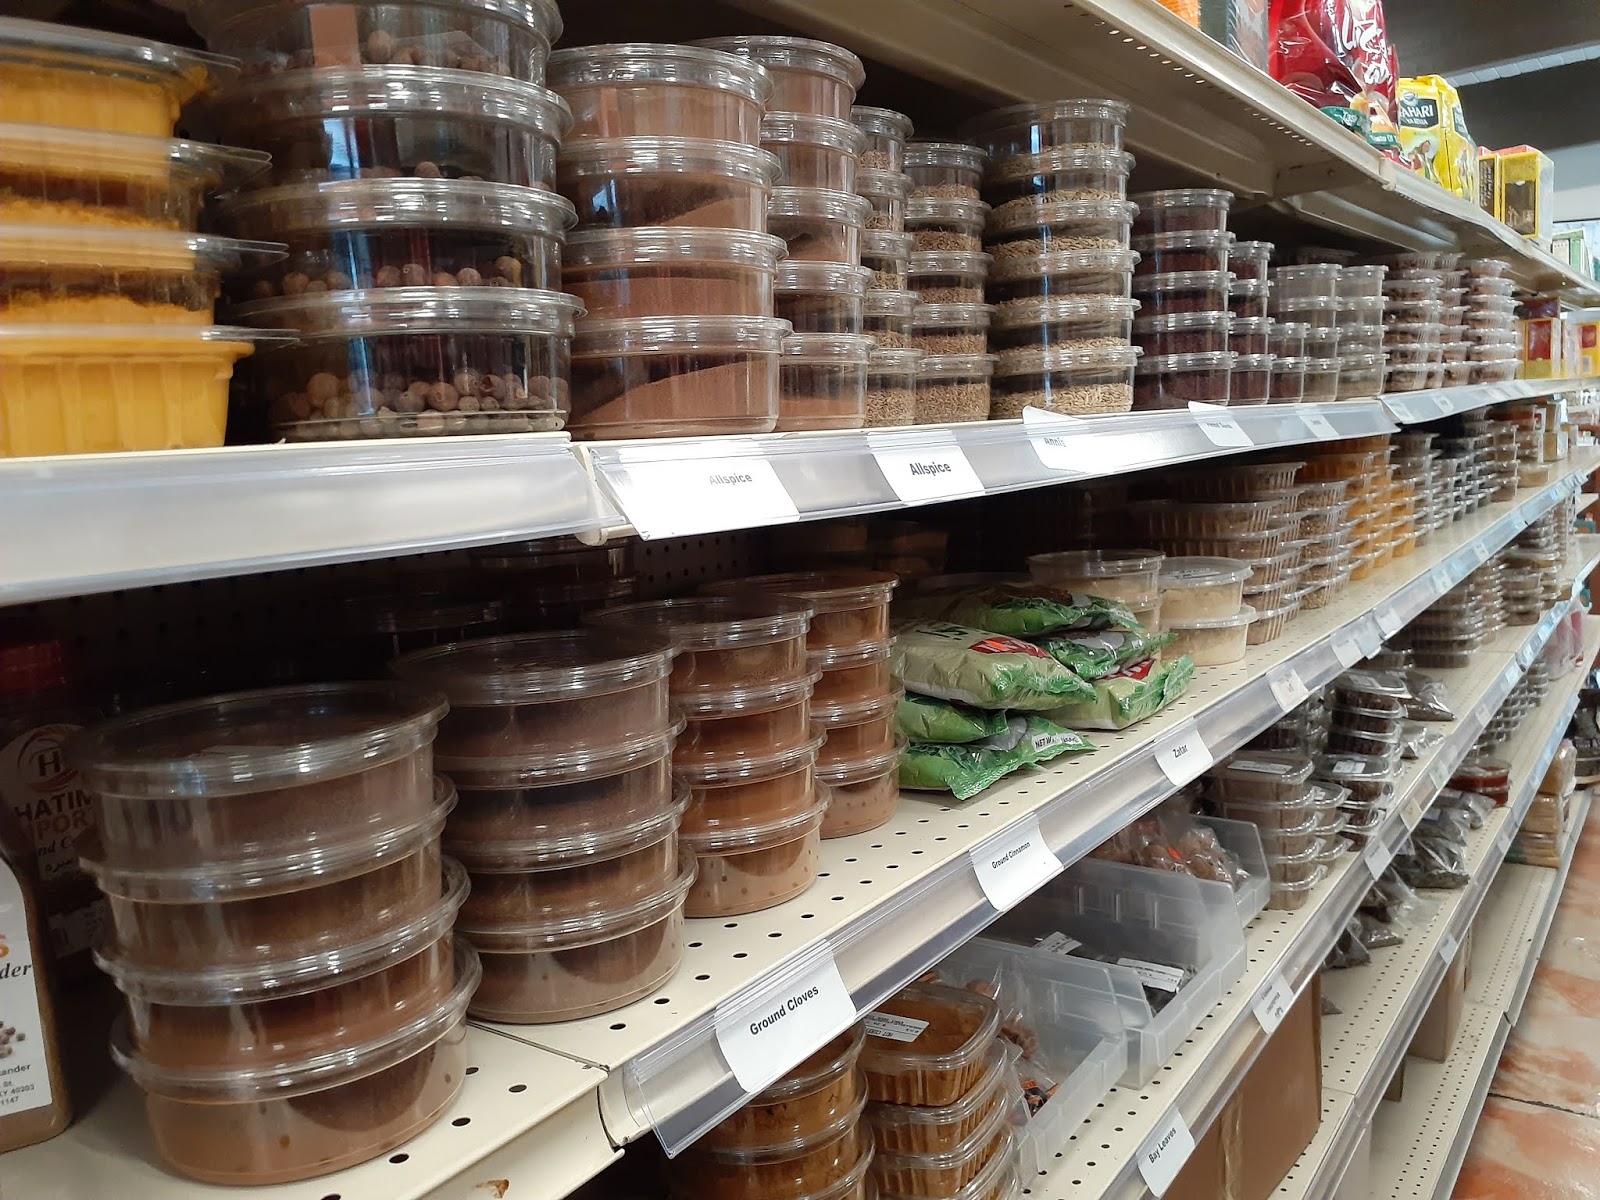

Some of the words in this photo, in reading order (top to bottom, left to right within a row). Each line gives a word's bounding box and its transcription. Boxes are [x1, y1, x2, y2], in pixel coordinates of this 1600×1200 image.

[708, 473, 753, 487] Allspice
[908, 461, 952, 477] Allspice
[992, 852, 1009, 869] Ground
[1008, 841, 1031, 859] Cinnamon
[749, 1005, 787, 1036] Ground
[786, 986, 819, 1012] Cloves
[1148, 1147, 1161, 1164] Bay
[1157, 1127, 1178, 1152] Leaves
